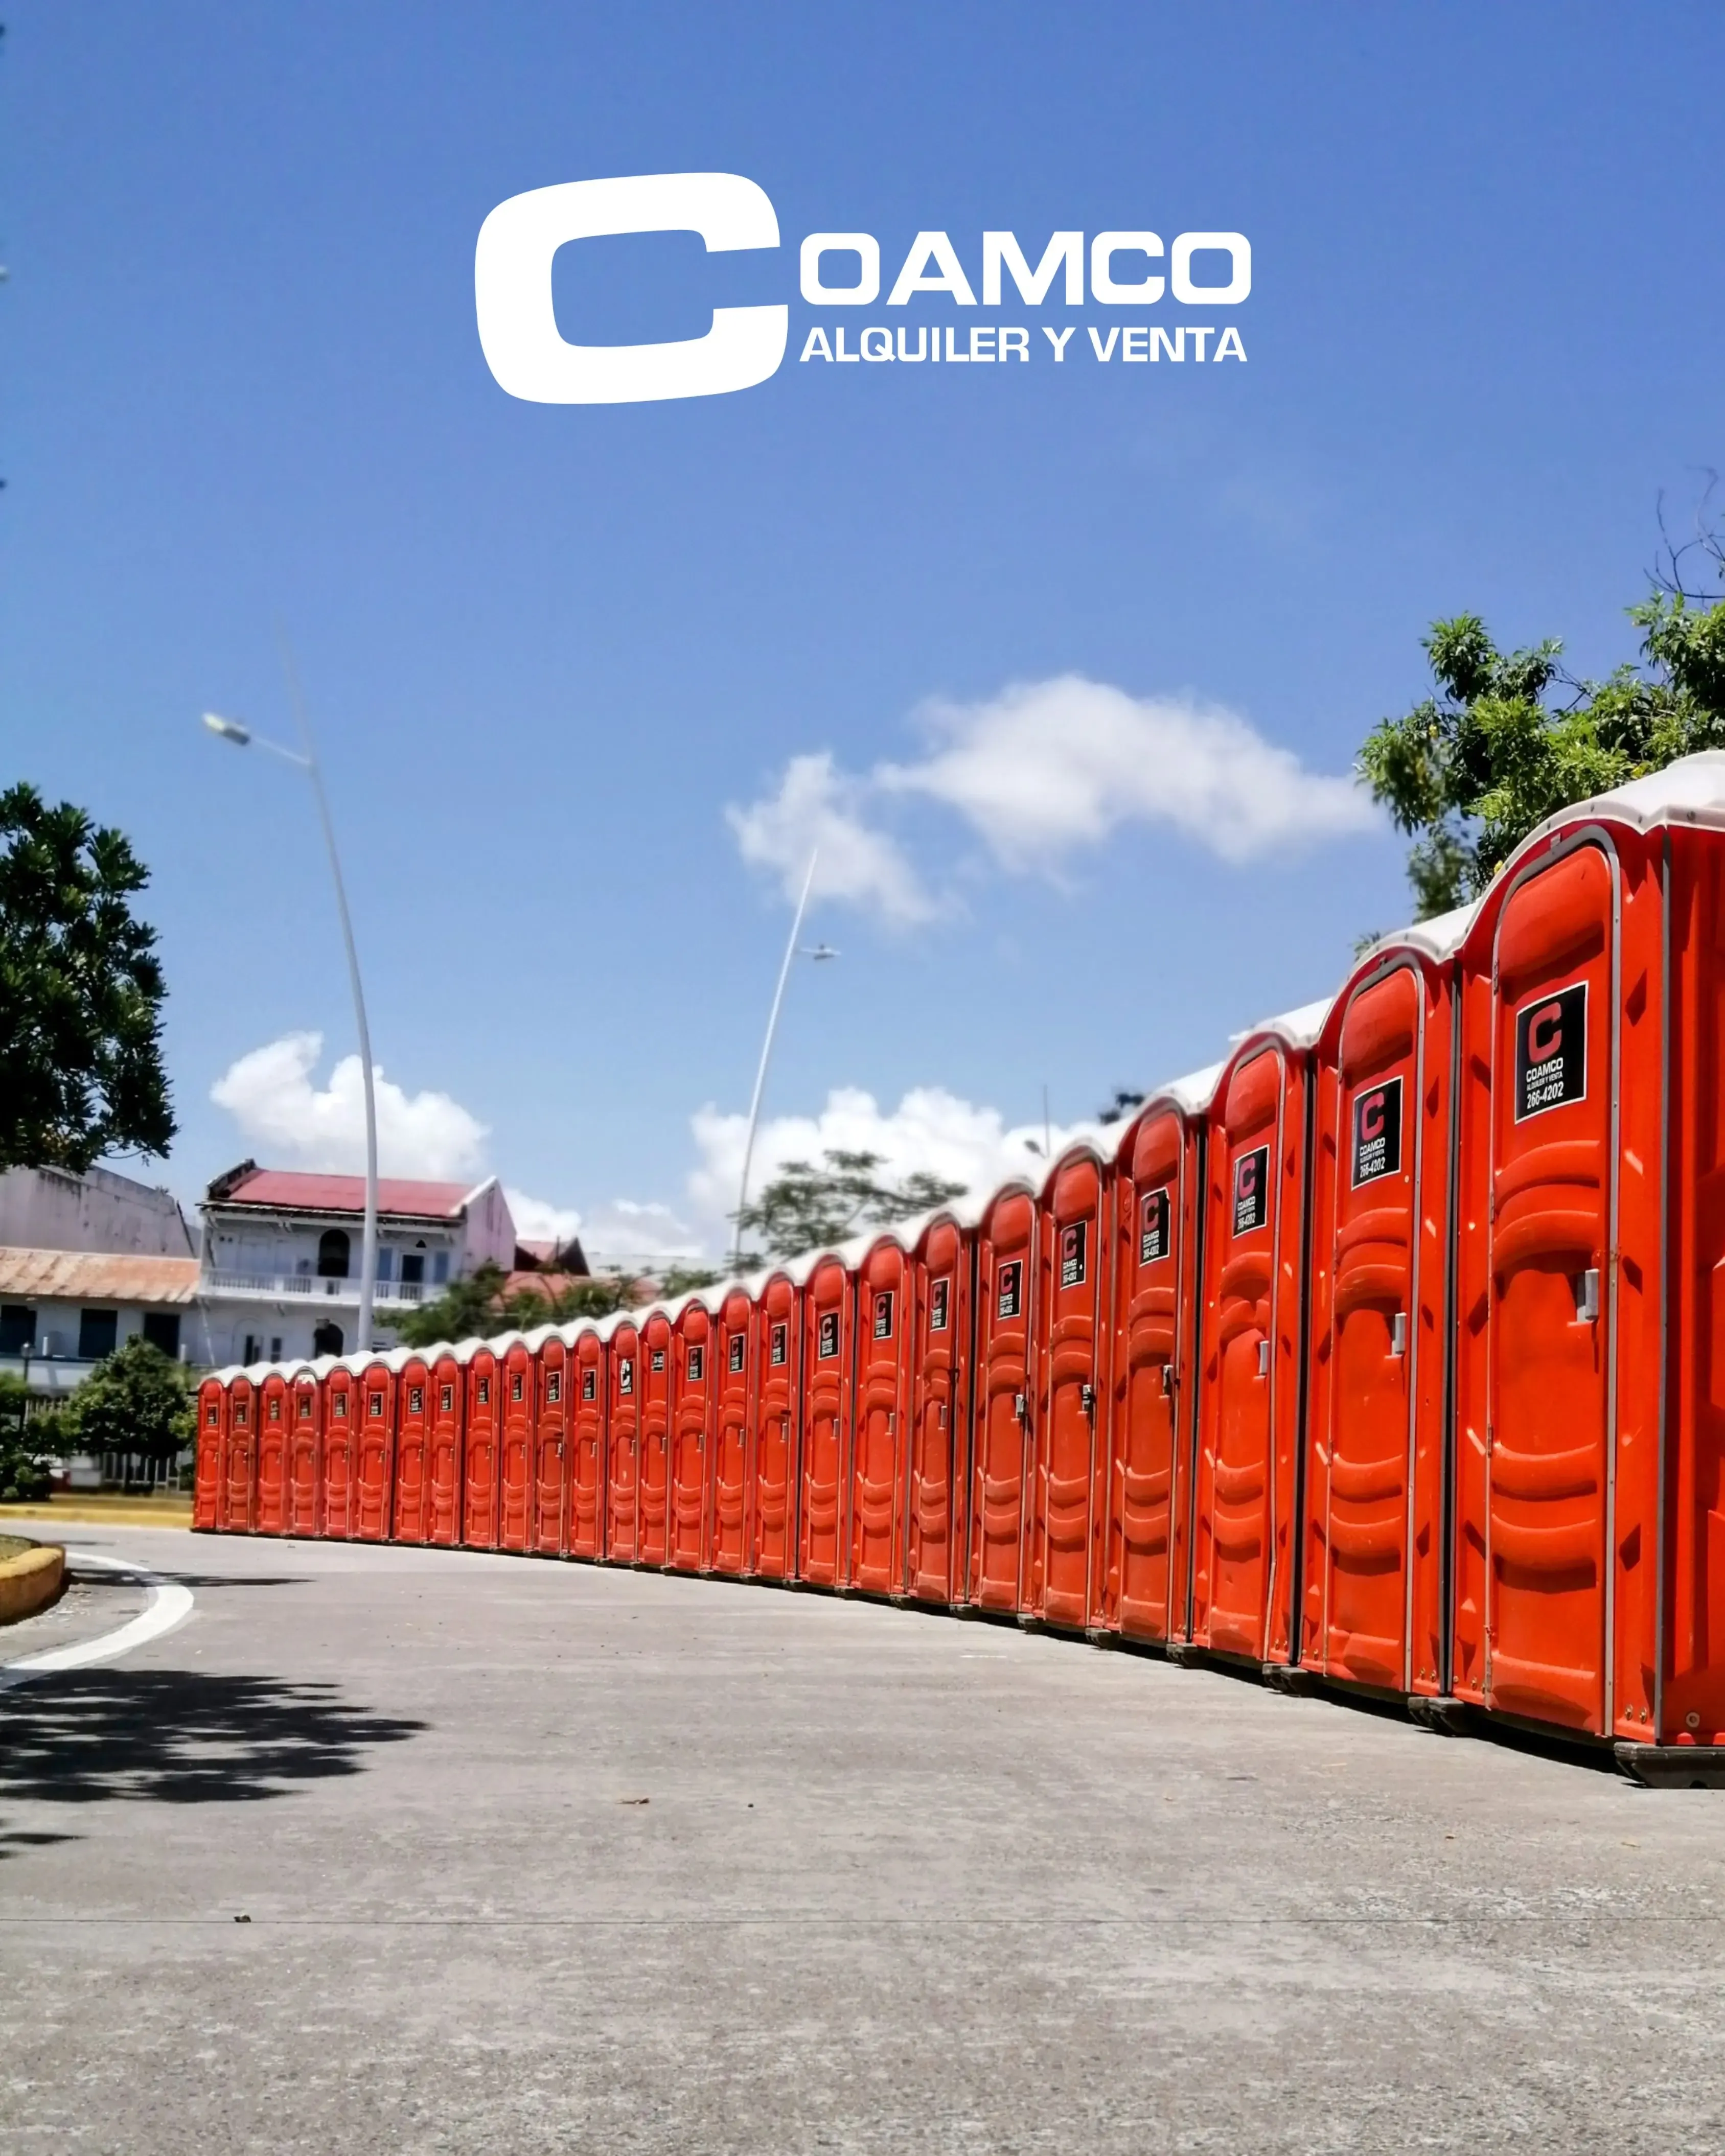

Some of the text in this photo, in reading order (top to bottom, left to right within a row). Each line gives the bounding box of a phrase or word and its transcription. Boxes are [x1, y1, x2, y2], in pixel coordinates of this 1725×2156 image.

[1527, 1058, 1563, 1082] COAMCO
[1527, 1081, 1563, 1109] 266-4202
[1360, 1137, 1385, 1156] COAMCO
